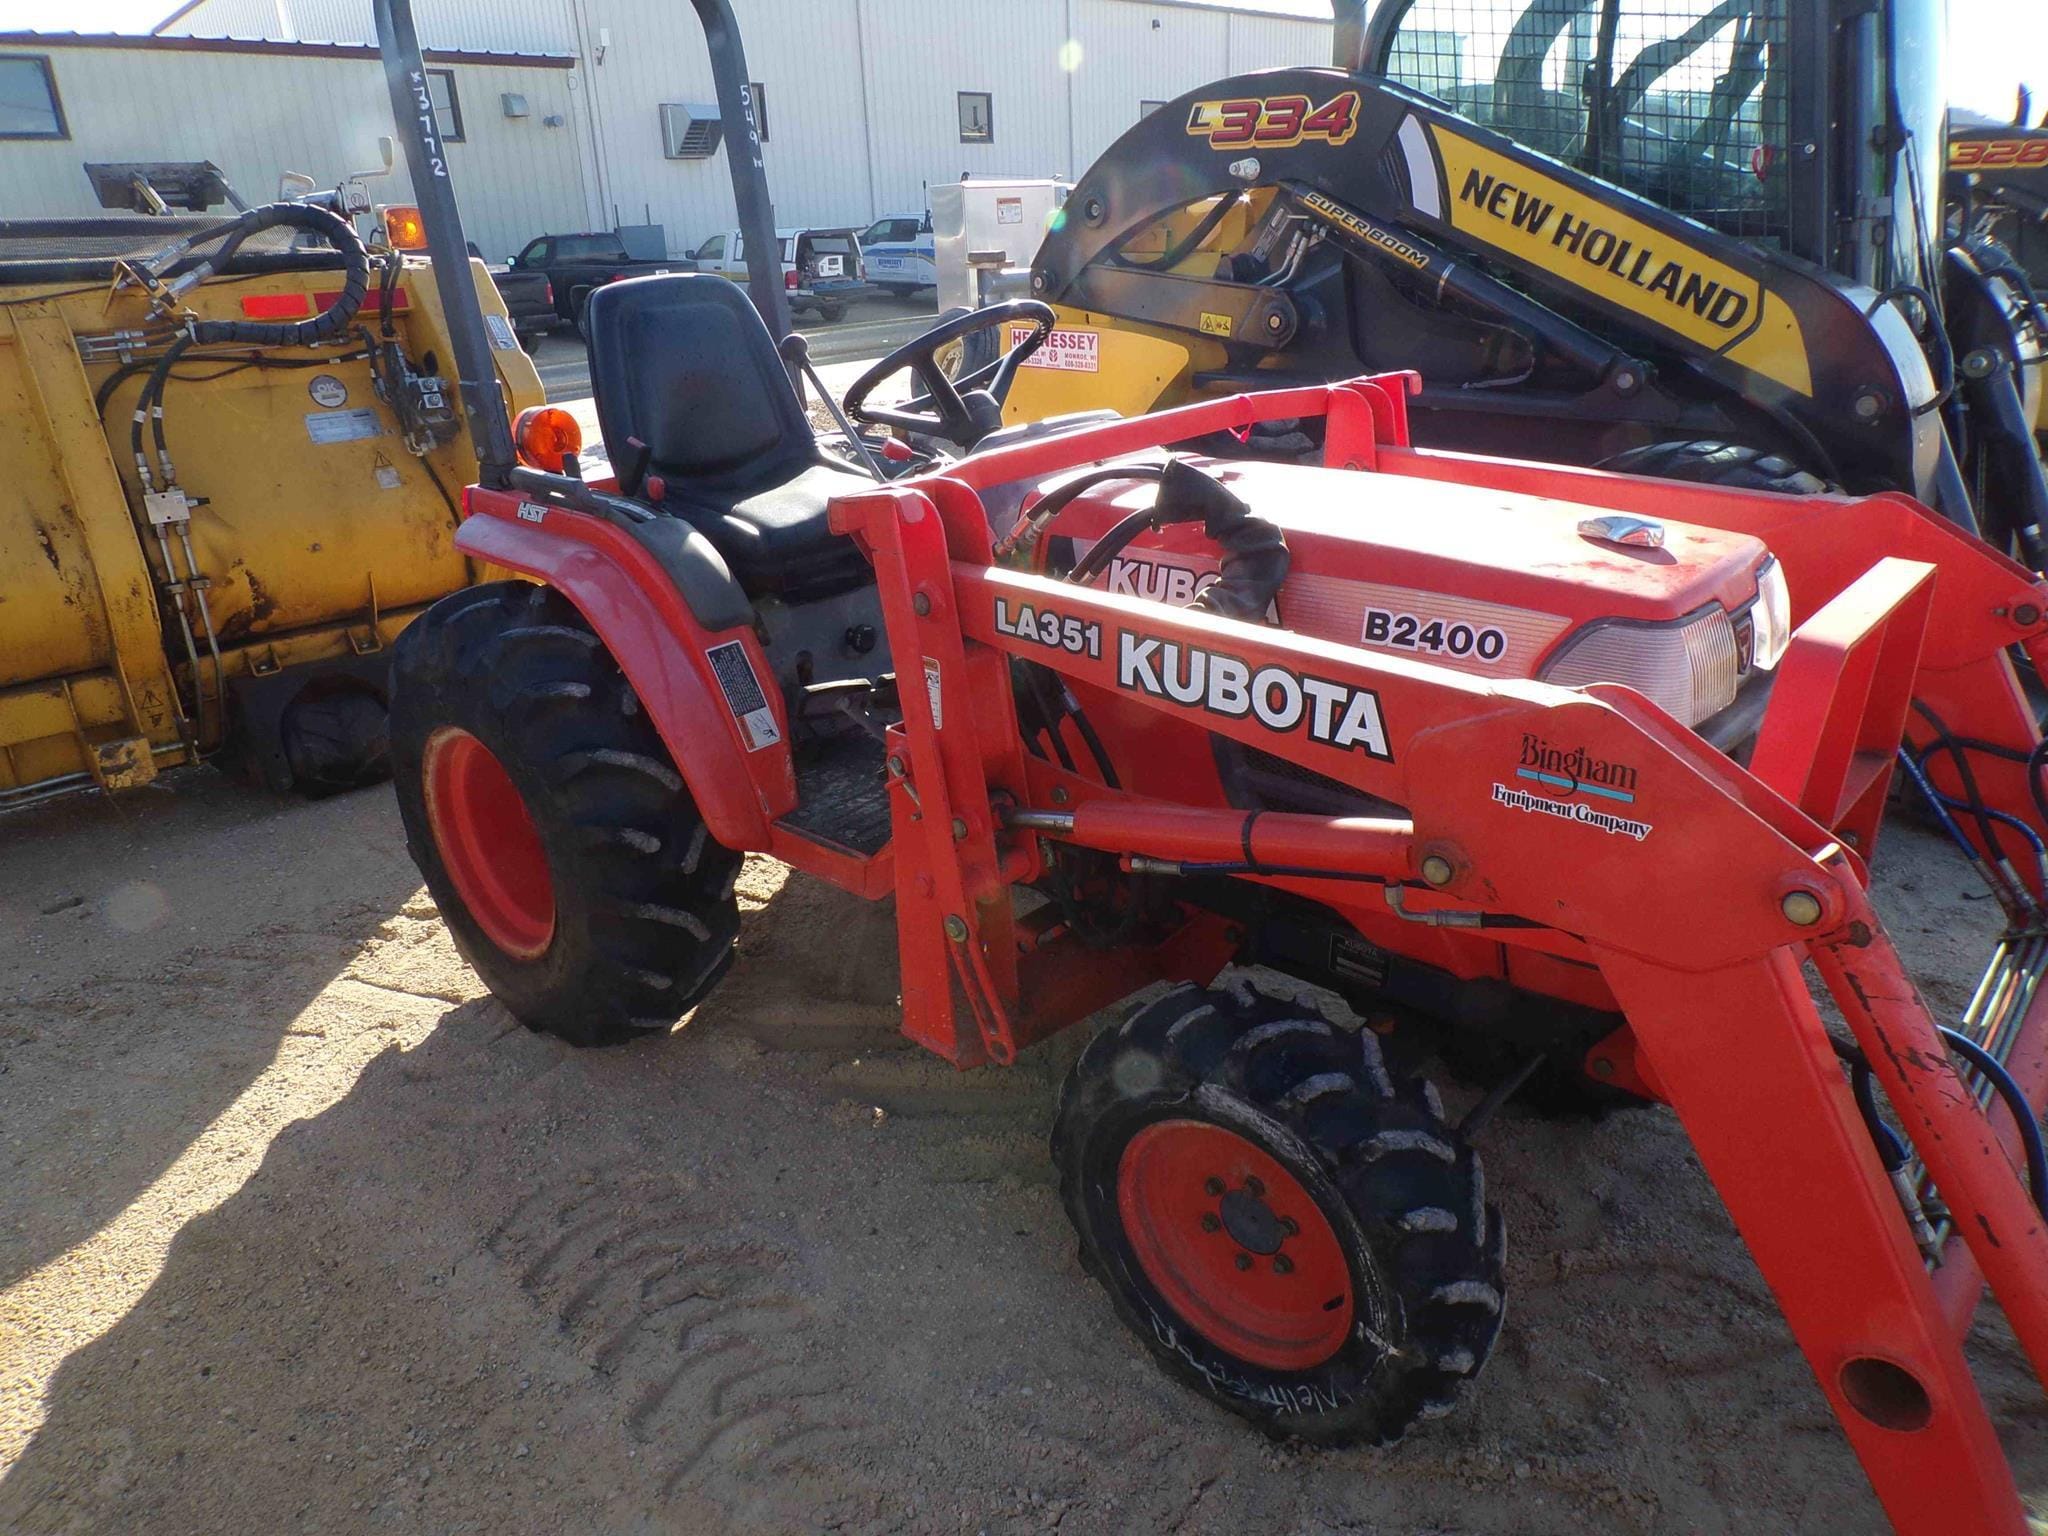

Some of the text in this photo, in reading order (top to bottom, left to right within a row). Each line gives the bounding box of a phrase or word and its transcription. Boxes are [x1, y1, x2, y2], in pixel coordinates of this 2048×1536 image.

[1187, 92, 1360, 149] L334
[1459, 167, 1749, 330] NEW HOLLAND
[1013, 330, 1097, 350] HENESSEY
[317, 382, 337, 393] OK
[517, 502, 548, 523] HST
[995, 598, 1100, 658] LA351
[1363, 609, 1506, 662] B2400
[1118, 630, 1392, 760] KUBOTA
[1518, 732, 1638, 796] Bingham
[1493, 784, 1652, 839] Equipment Company
